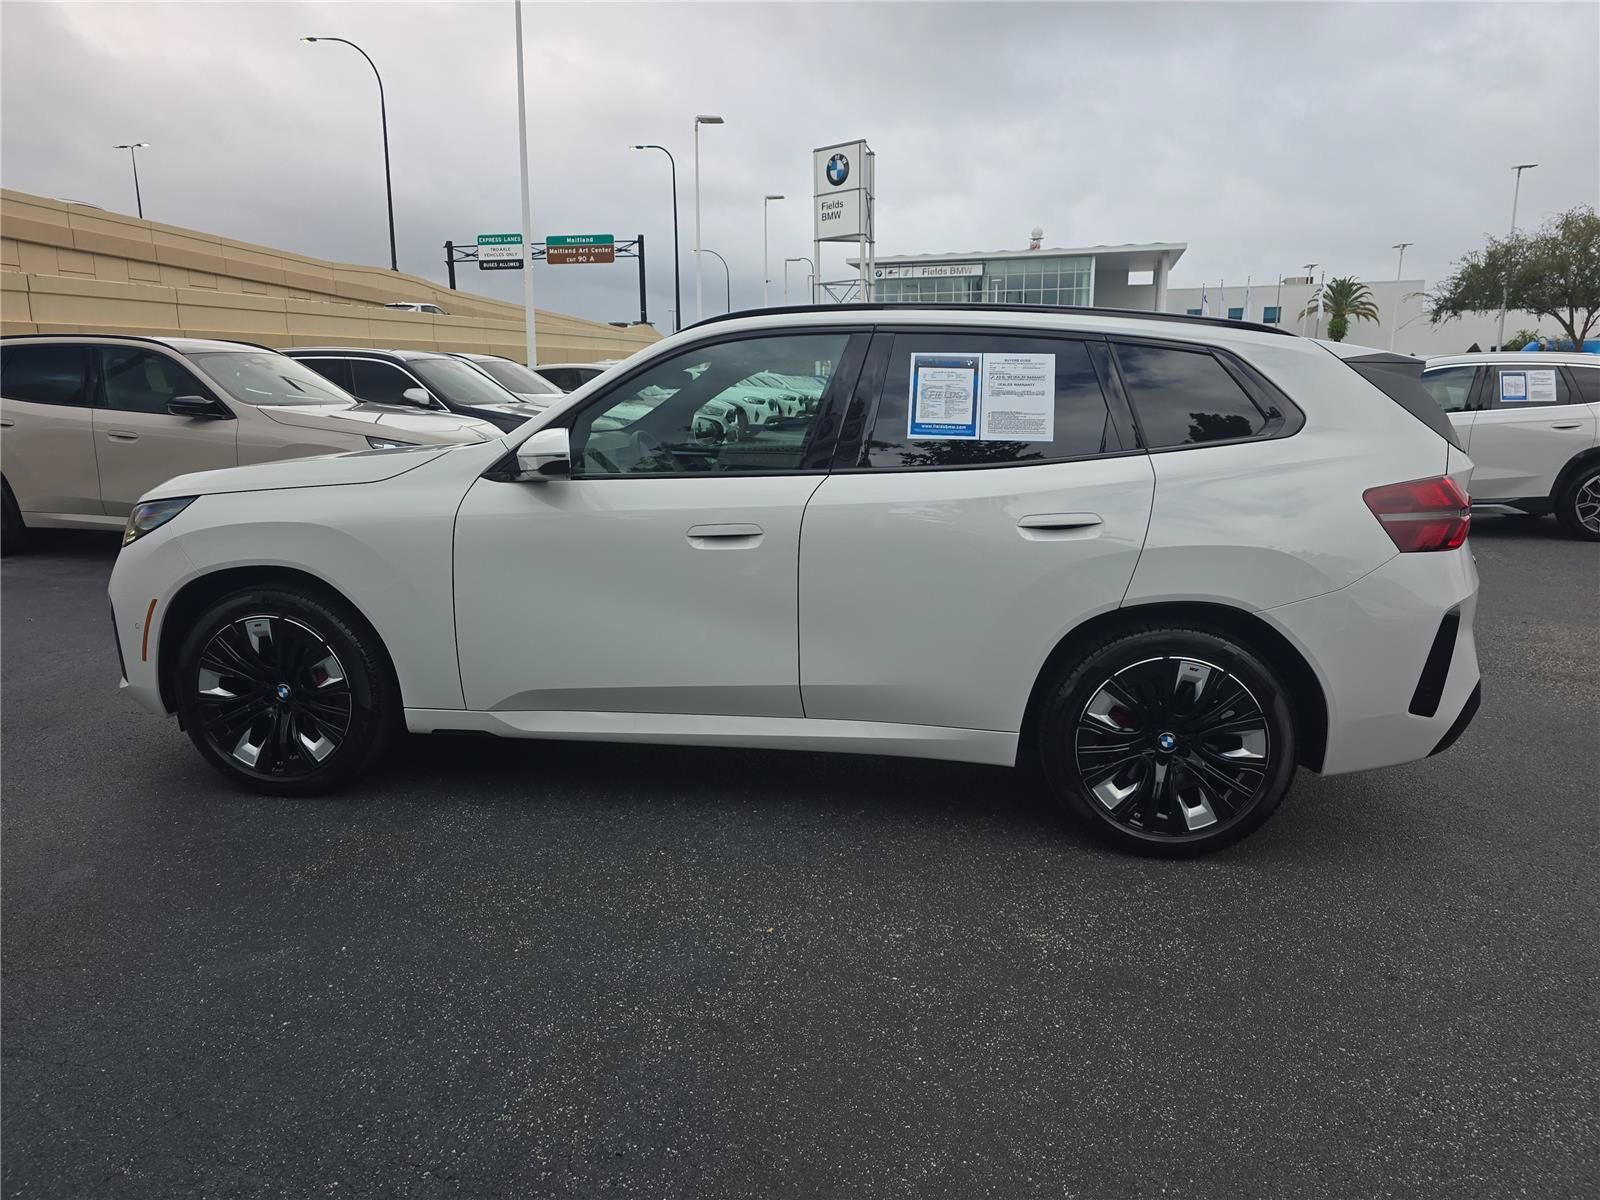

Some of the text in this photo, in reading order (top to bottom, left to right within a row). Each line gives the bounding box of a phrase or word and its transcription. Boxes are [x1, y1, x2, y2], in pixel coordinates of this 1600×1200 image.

[821, 200, 844, 211] Fields
[821, 211, 842, 222] BMW
[549, 247, 576, 255] Maitland
[577, 255, 587, 263] 90
[922, 266, 973, 276] Fields BMW
